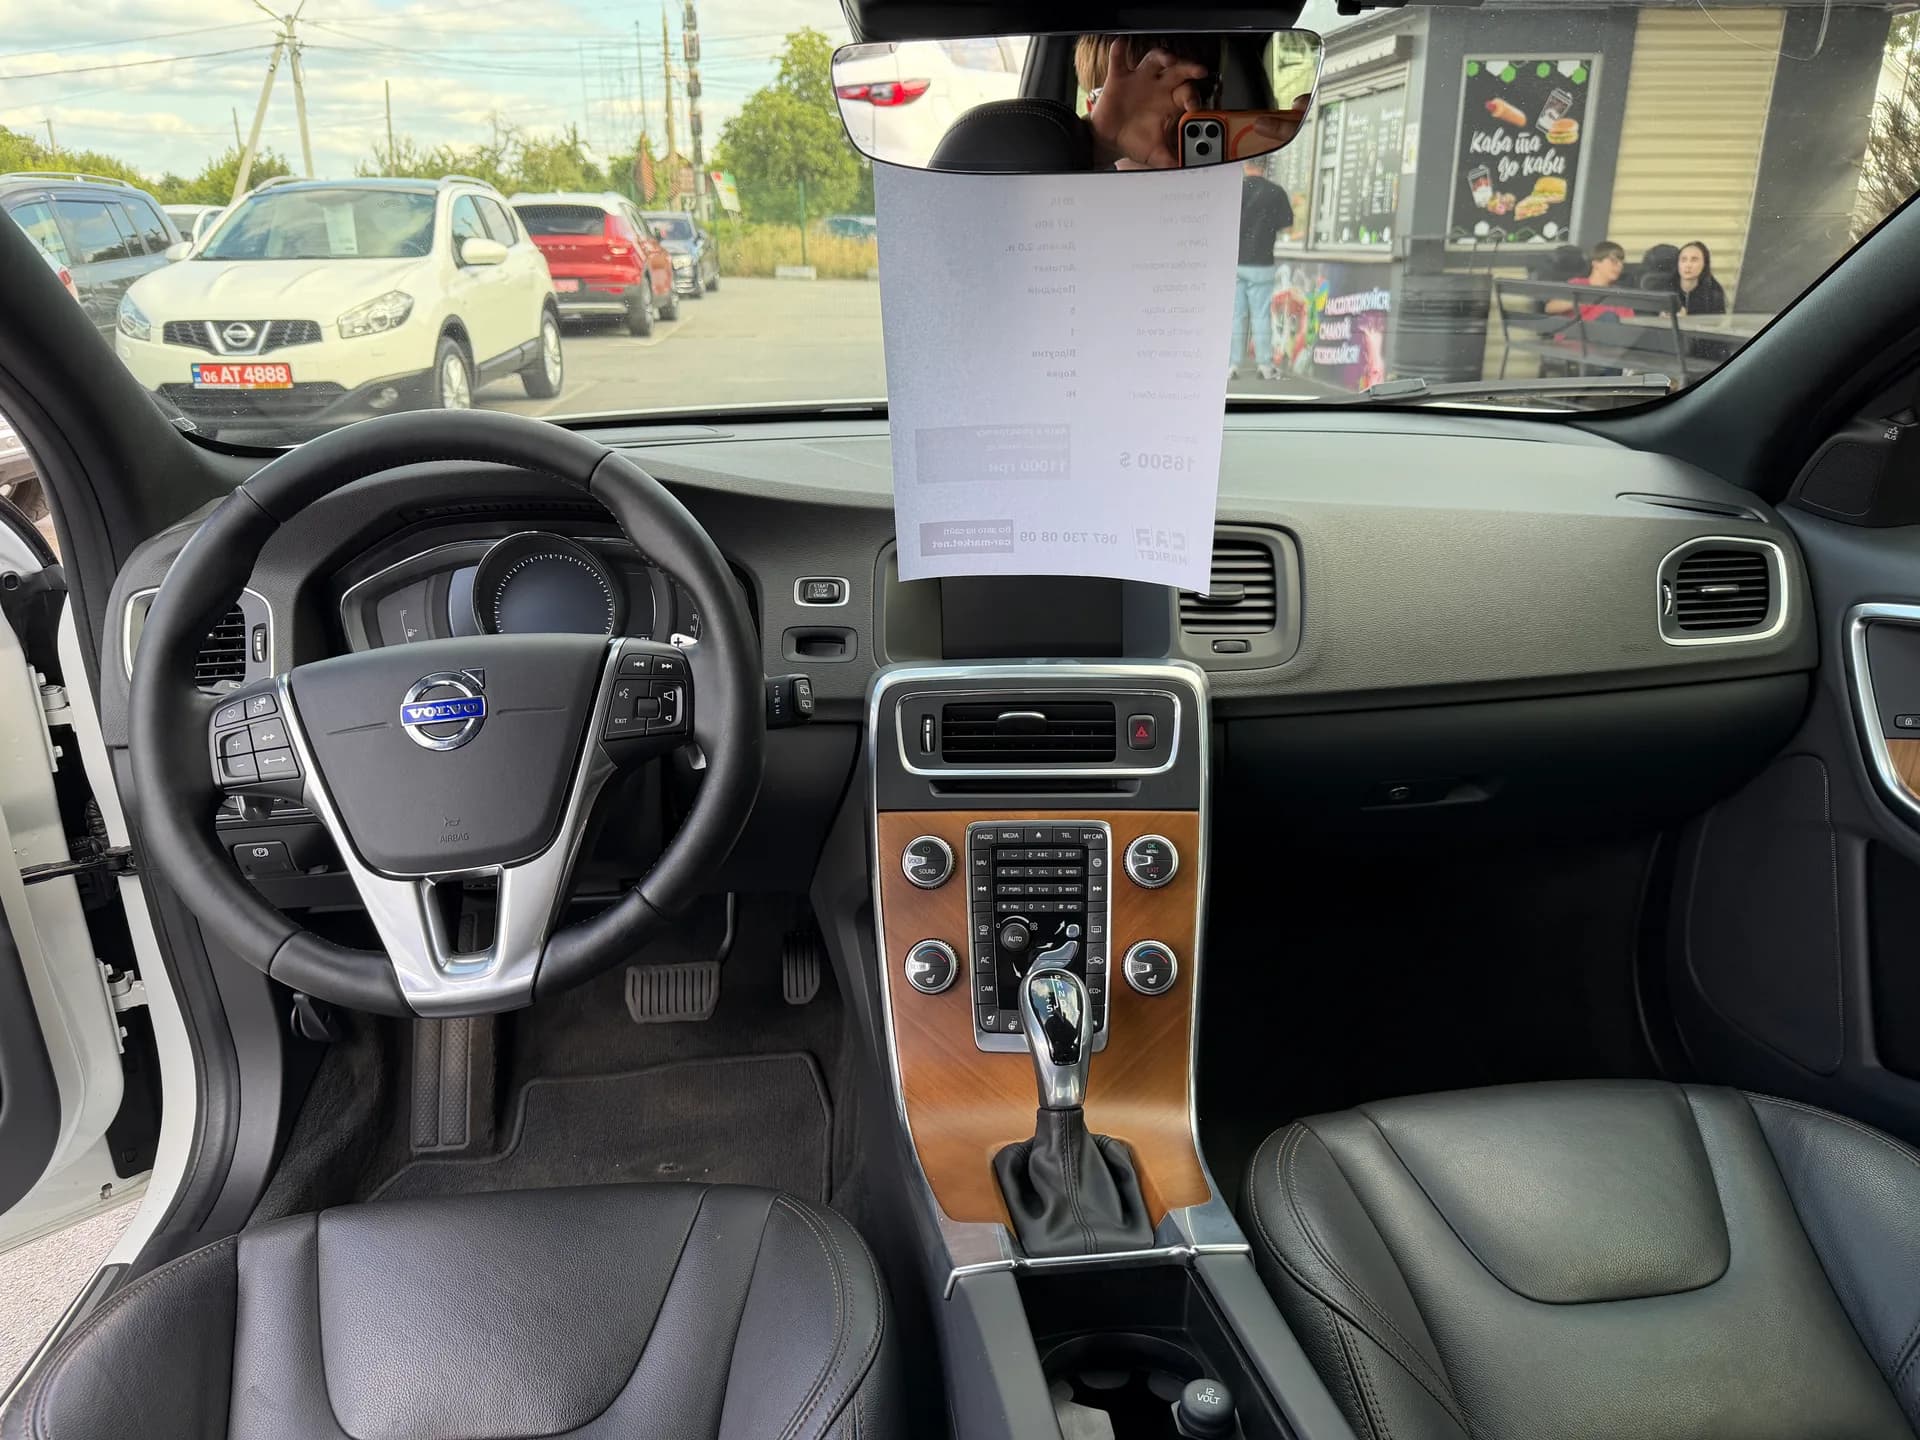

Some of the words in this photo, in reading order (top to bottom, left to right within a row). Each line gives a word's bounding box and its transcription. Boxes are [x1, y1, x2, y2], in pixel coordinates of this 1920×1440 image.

[1469, 127, 1512, 155] Кава
[1514, 132, 1541, 154] та
[1497, 156, 1519, 182] до
[1522, 147, 1565, 176] кави
[202, 370, 219, 383] 06
[221, 366, 241, 383] AT
[243, 366, 288, 383] 4888
[406, 703, 479, 719] VOLVO
[440, 832, 470, 843] AIRBAG
[980, 956, 990, 964] AC
[1046, 1003, 1053, 1013] S
[1205, 1387, 1215, 1396] 12
[1196, 1392, 1221, 1405] VOLT
